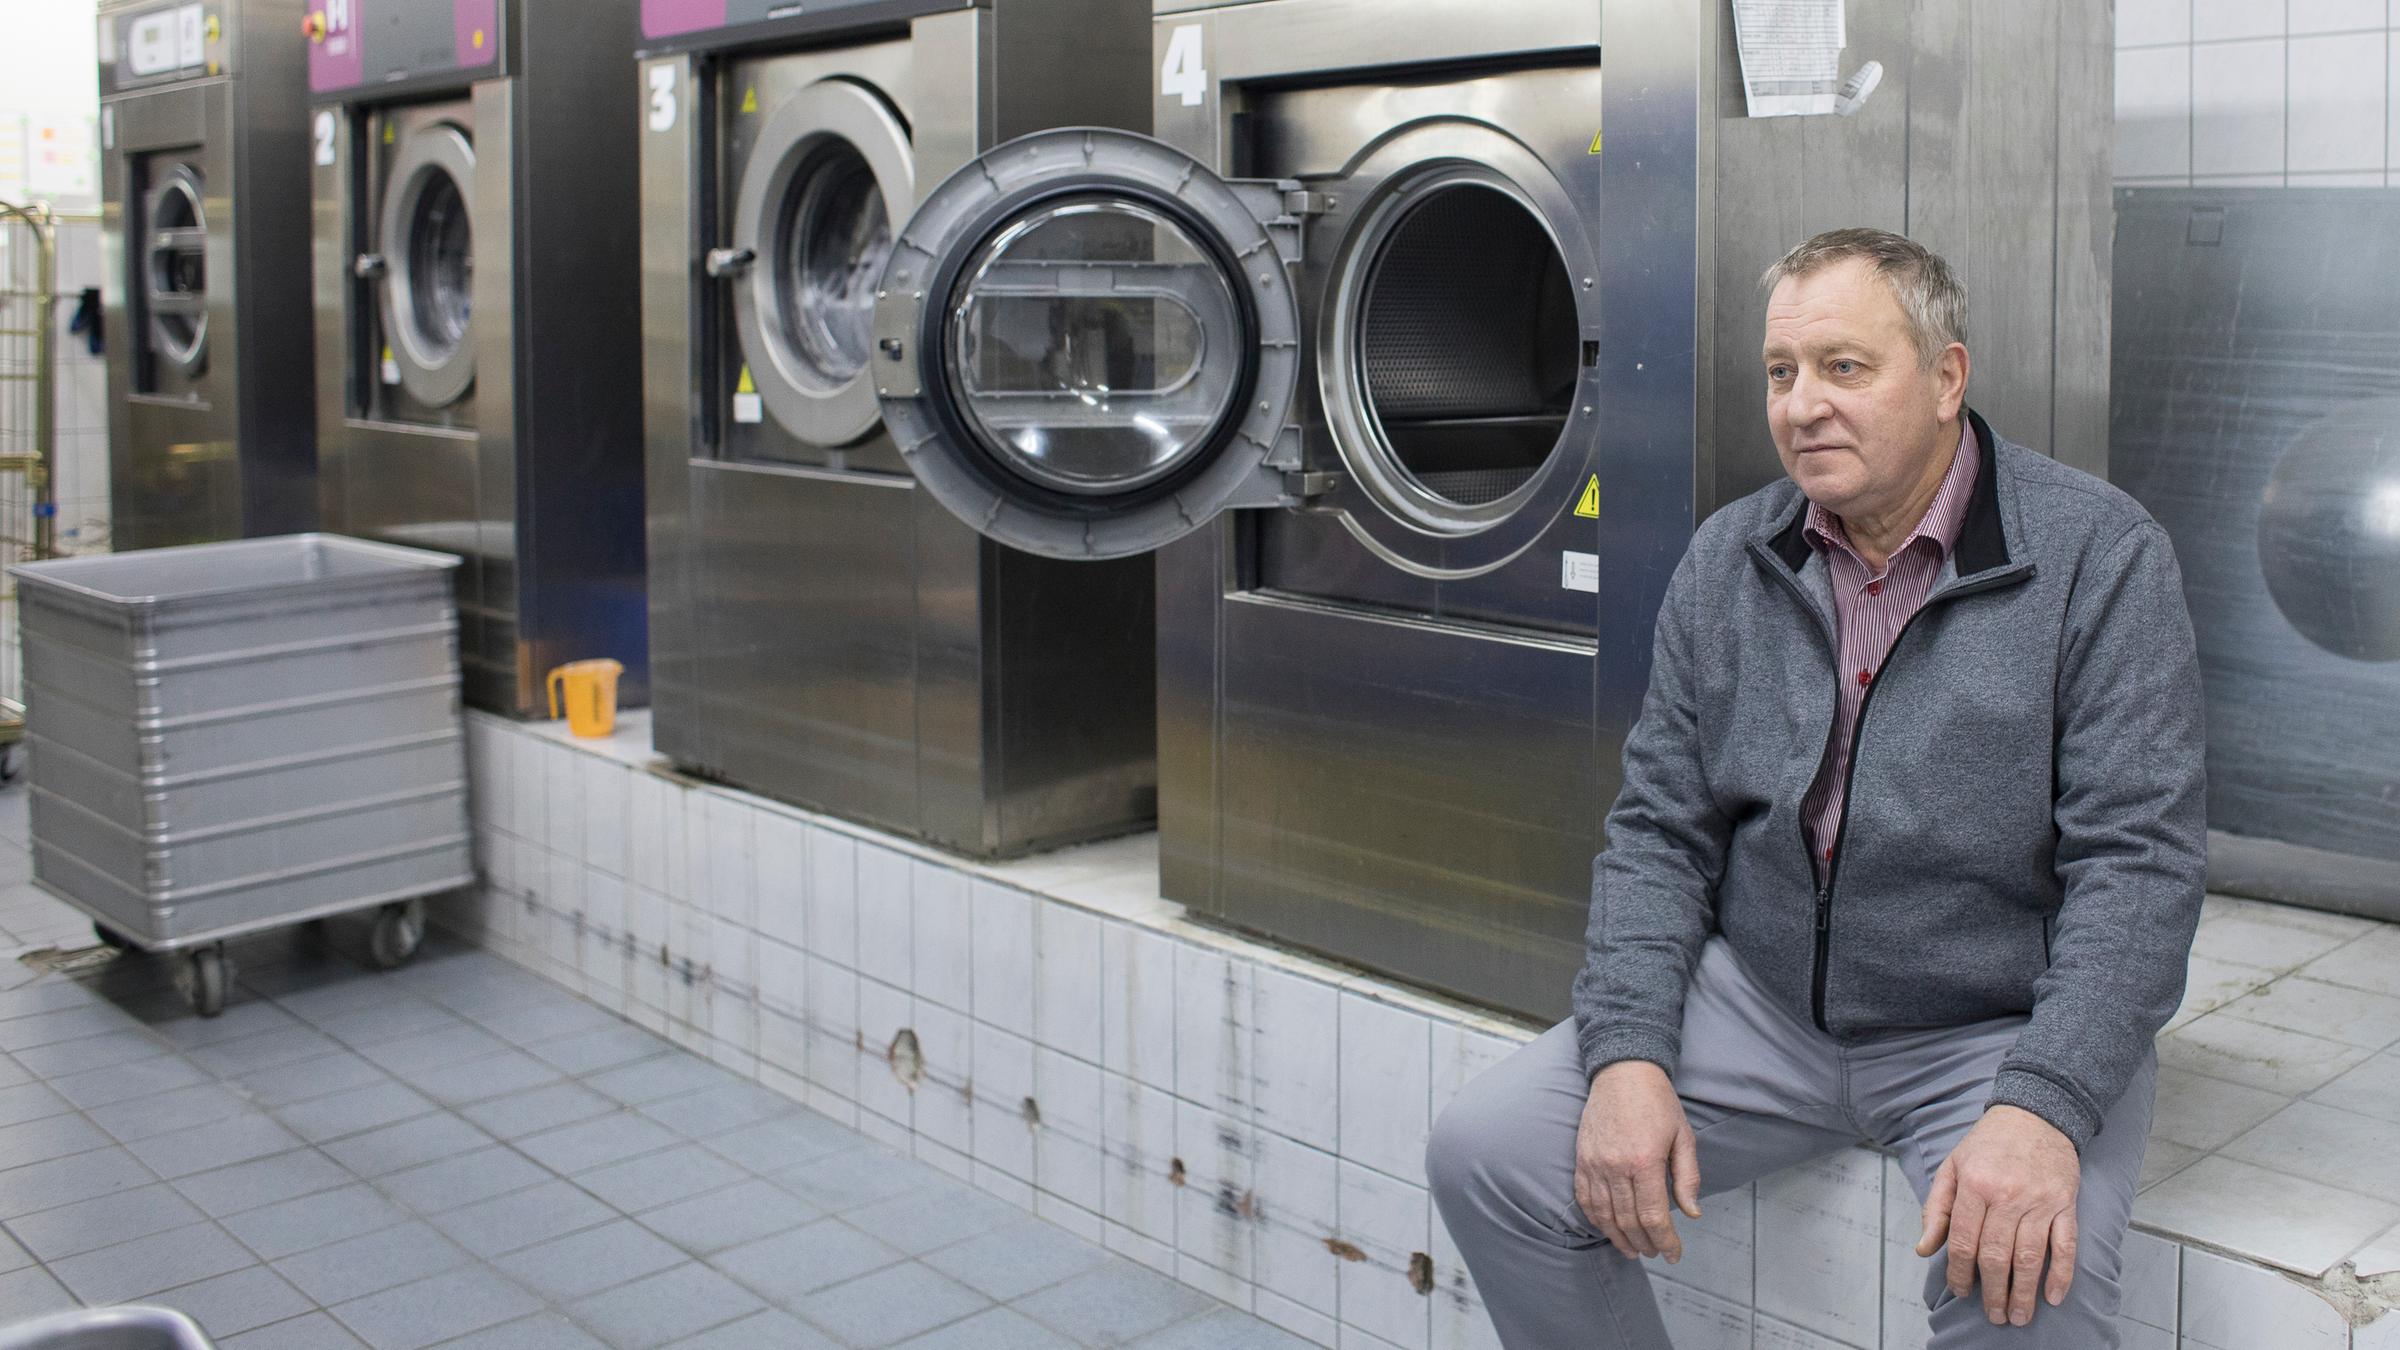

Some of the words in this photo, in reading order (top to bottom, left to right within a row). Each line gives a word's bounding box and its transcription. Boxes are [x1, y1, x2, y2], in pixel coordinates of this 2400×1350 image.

[649, 64, 677, 133] 3
[1161, 23, 1207, 107] 4
[314, 110, 336, 167] 2
